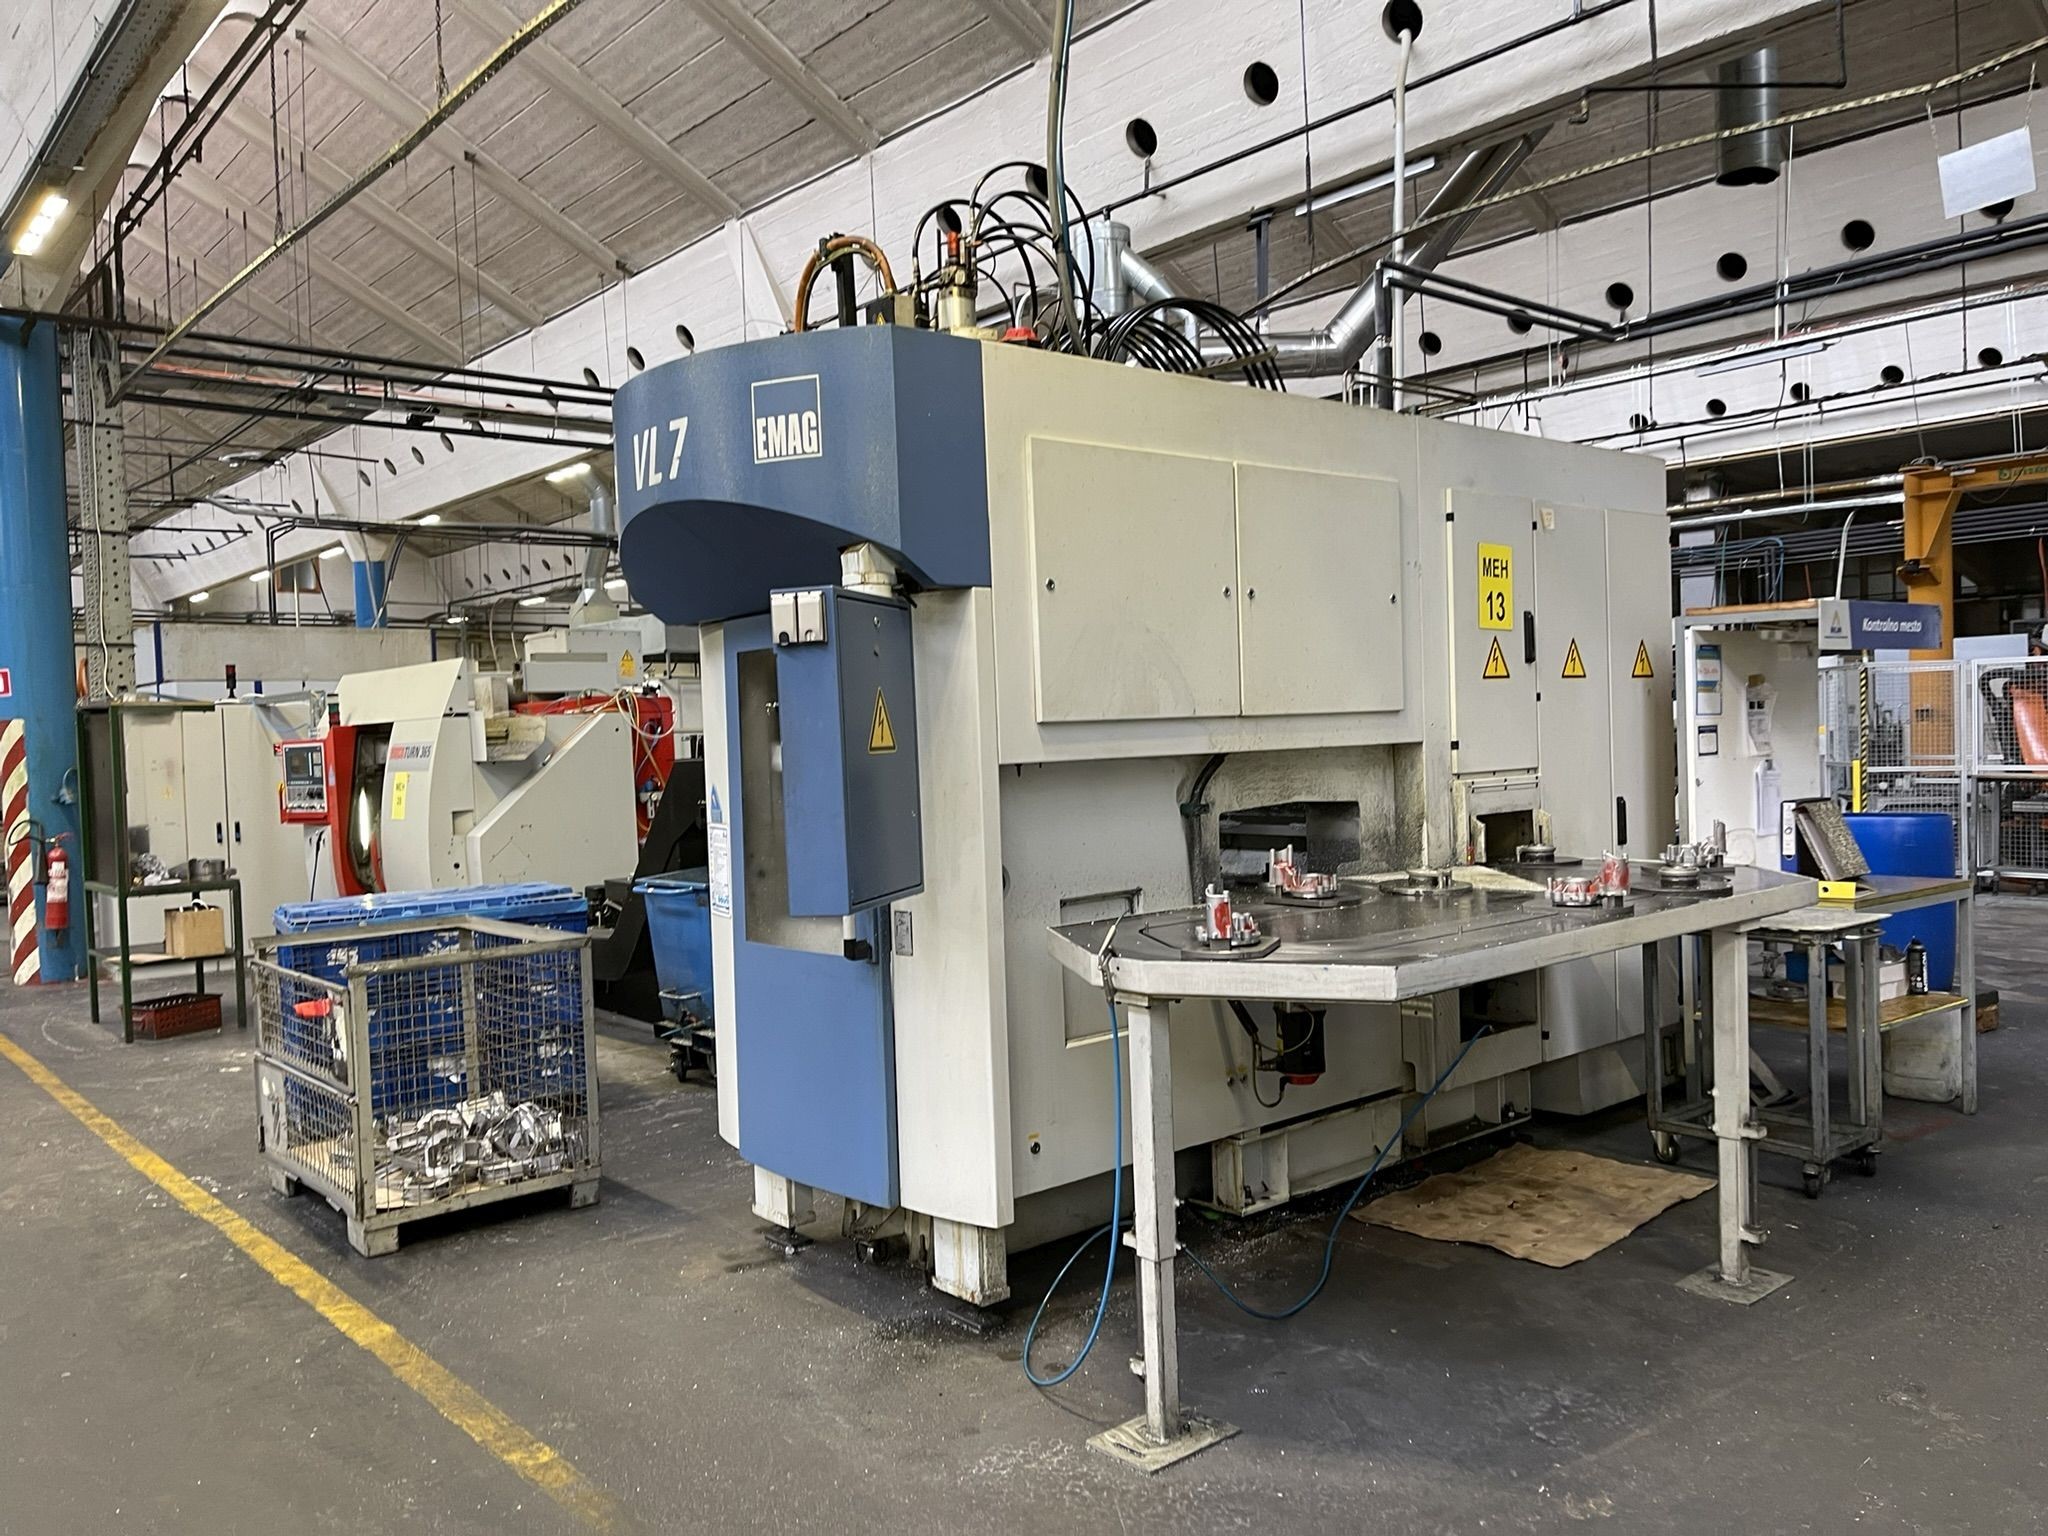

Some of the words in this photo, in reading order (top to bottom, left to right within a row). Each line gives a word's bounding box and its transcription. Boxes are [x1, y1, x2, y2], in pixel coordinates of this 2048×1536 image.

[756, 410, 819, 459] EMAG
[633, 426, 663, 492] VL
[669, 416, 688, 480] 7
[1482, 557, 1509, 579] MEH
[1486, 591, 1506, 621] 13
[1899, 620, 1922, 633] mesto
